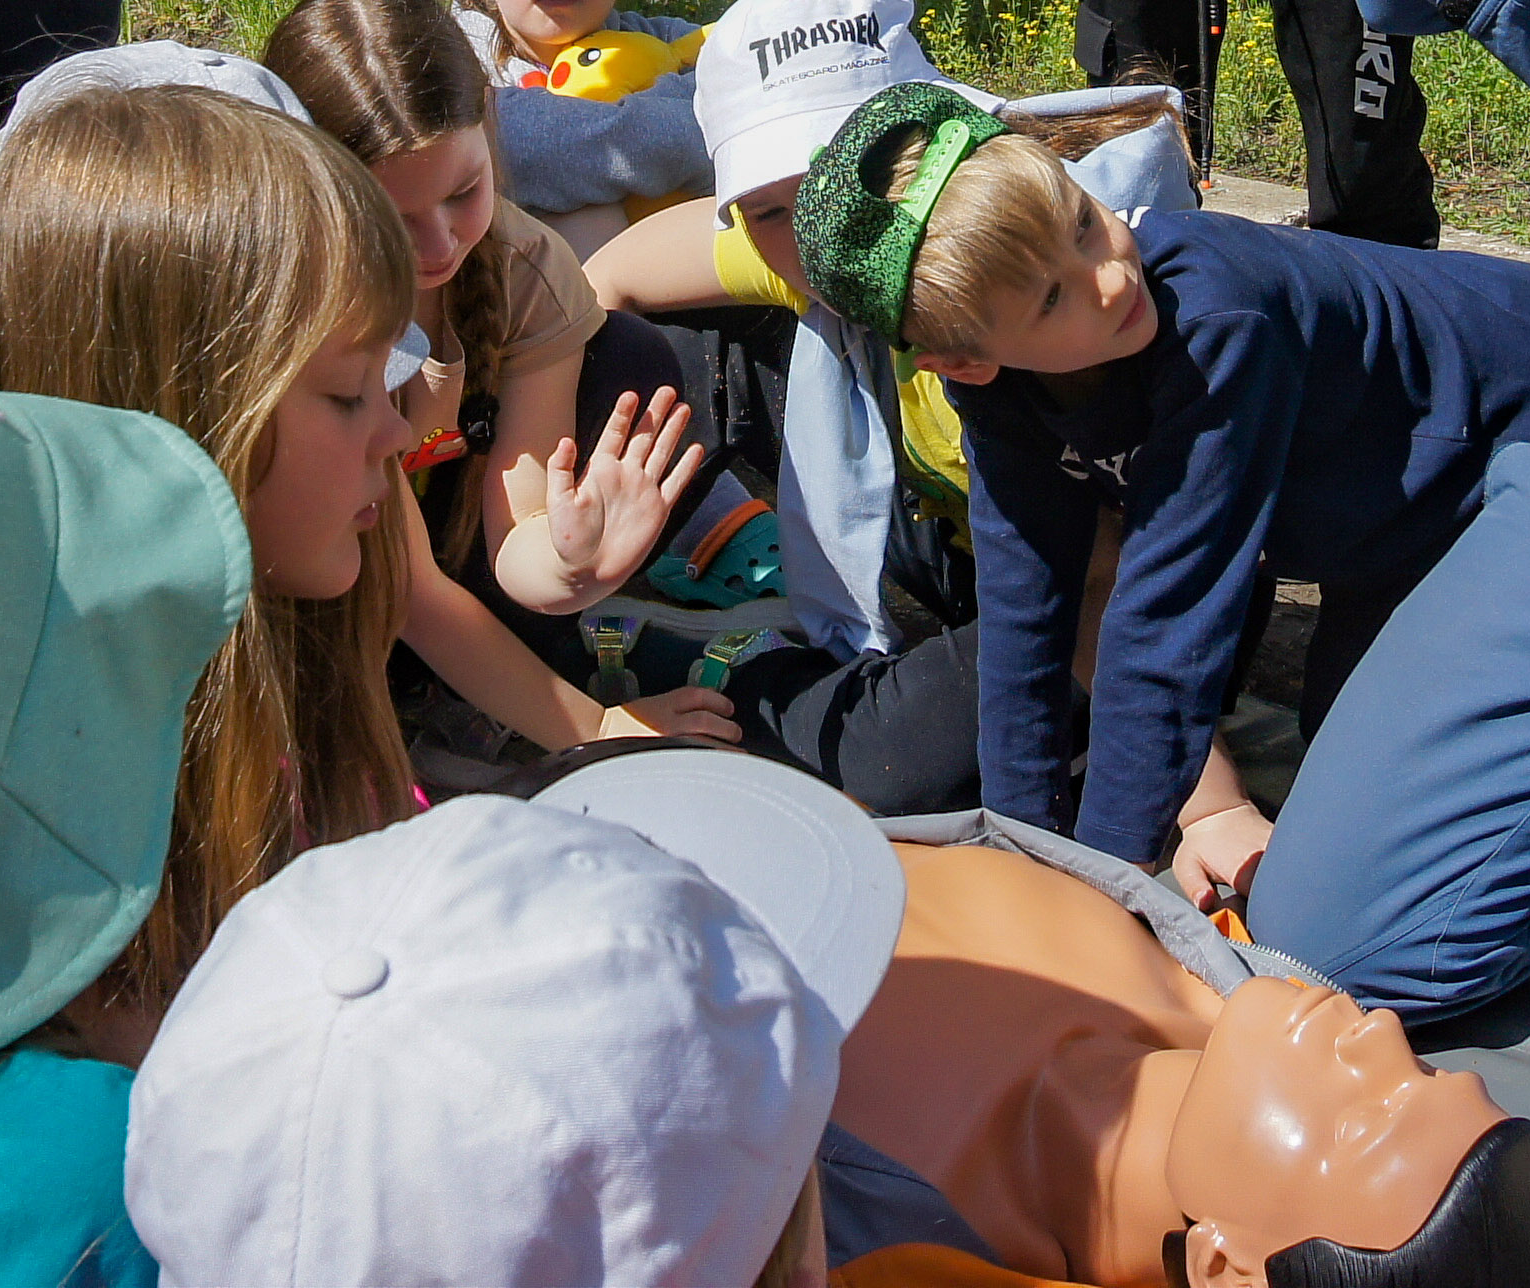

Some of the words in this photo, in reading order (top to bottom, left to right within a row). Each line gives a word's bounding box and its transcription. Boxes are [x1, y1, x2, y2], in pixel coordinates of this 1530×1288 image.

[748, 10, 887, 83] THRASHER
[762, 64, 839, 92] SKATEBOARD
[840, 55, 891, 72] MAGAZINE
